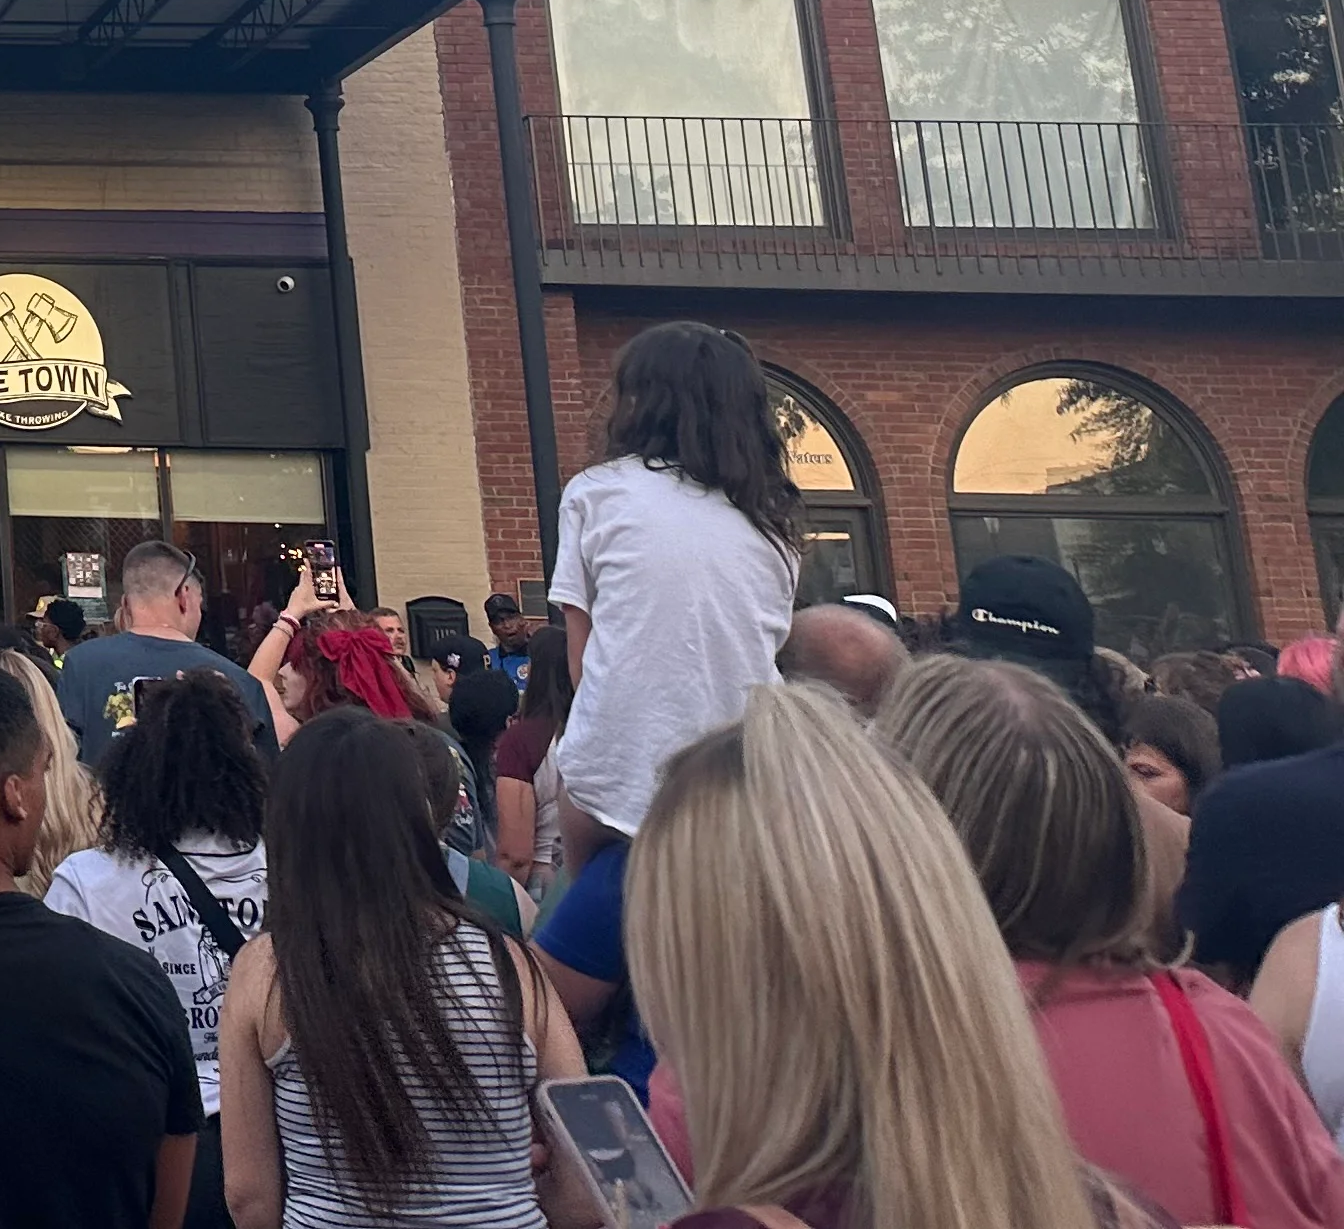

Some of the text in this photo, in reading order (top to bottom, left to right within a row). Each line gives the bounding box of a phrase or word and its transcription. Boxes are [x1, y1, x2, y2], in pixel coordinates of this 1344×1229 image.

[18, 365, 100, 397] TOWN
[15, 410, 69, 425] THROWING
[971, 608, 1060, 634] Champion
[162, 961, 198, 975] SINCE
